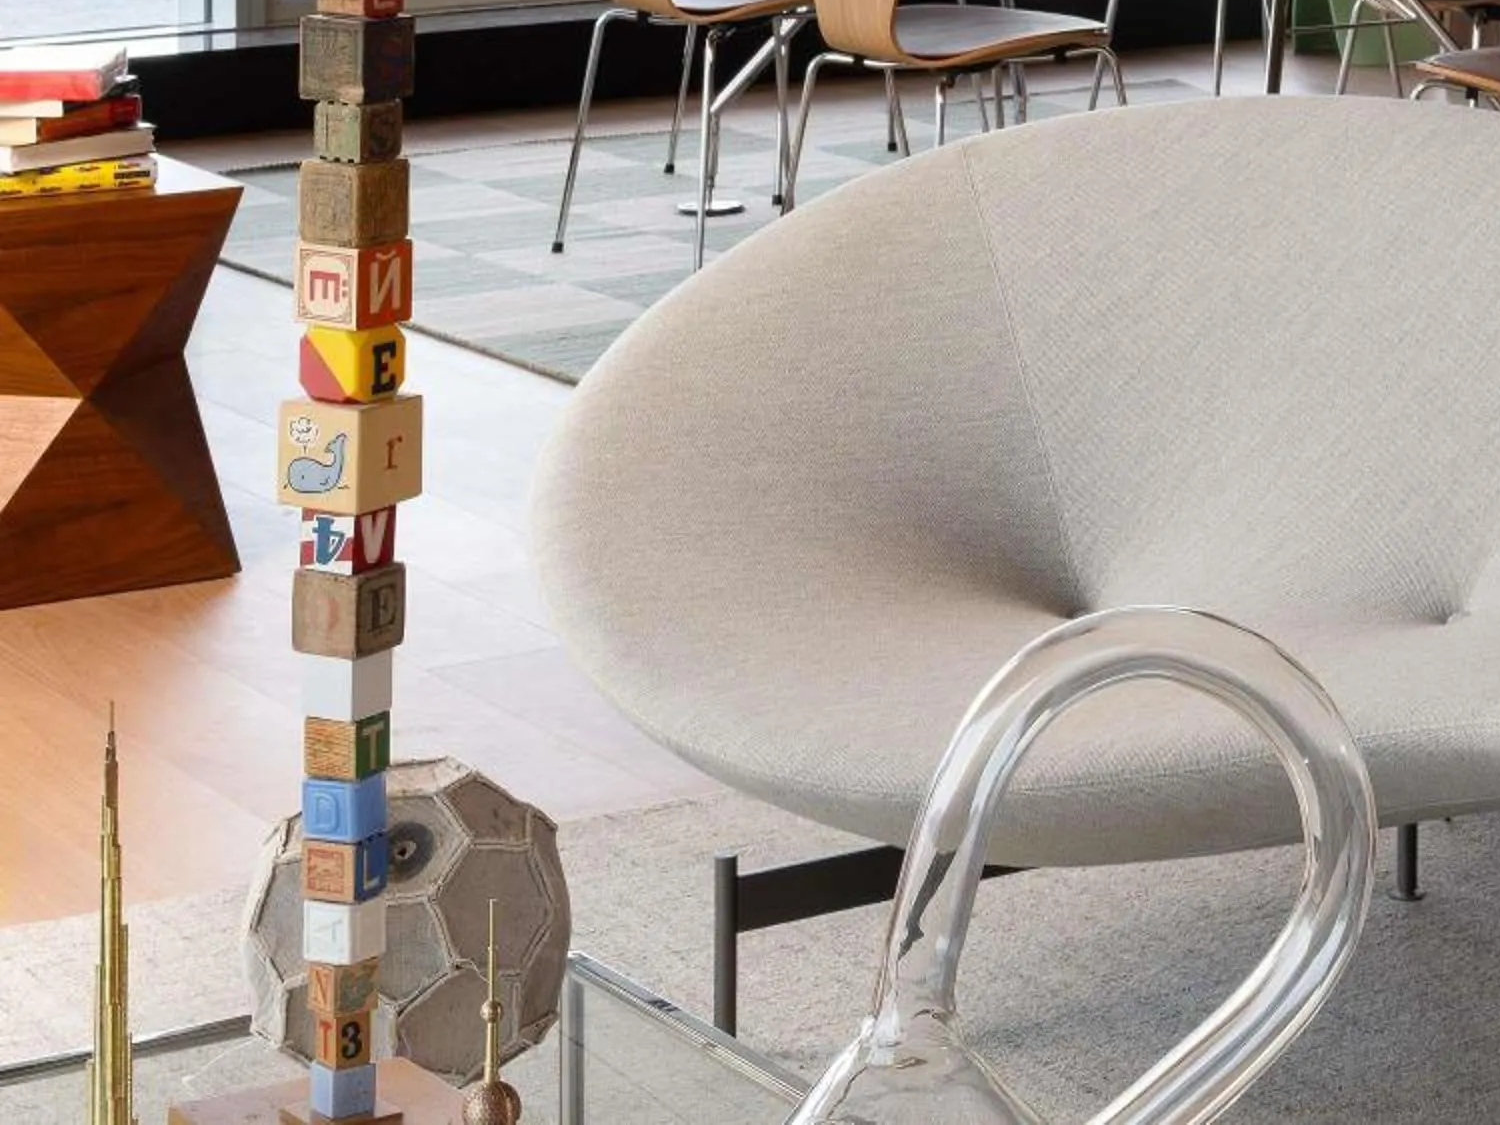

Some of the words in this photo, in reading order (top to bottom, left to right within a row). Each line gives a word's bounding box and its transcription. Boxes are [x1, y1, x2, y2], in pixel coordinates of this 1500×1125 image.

[371, 340, 397, 396] E
[361, 725, 386, 770] T
[362, 842, 381, 890] L
